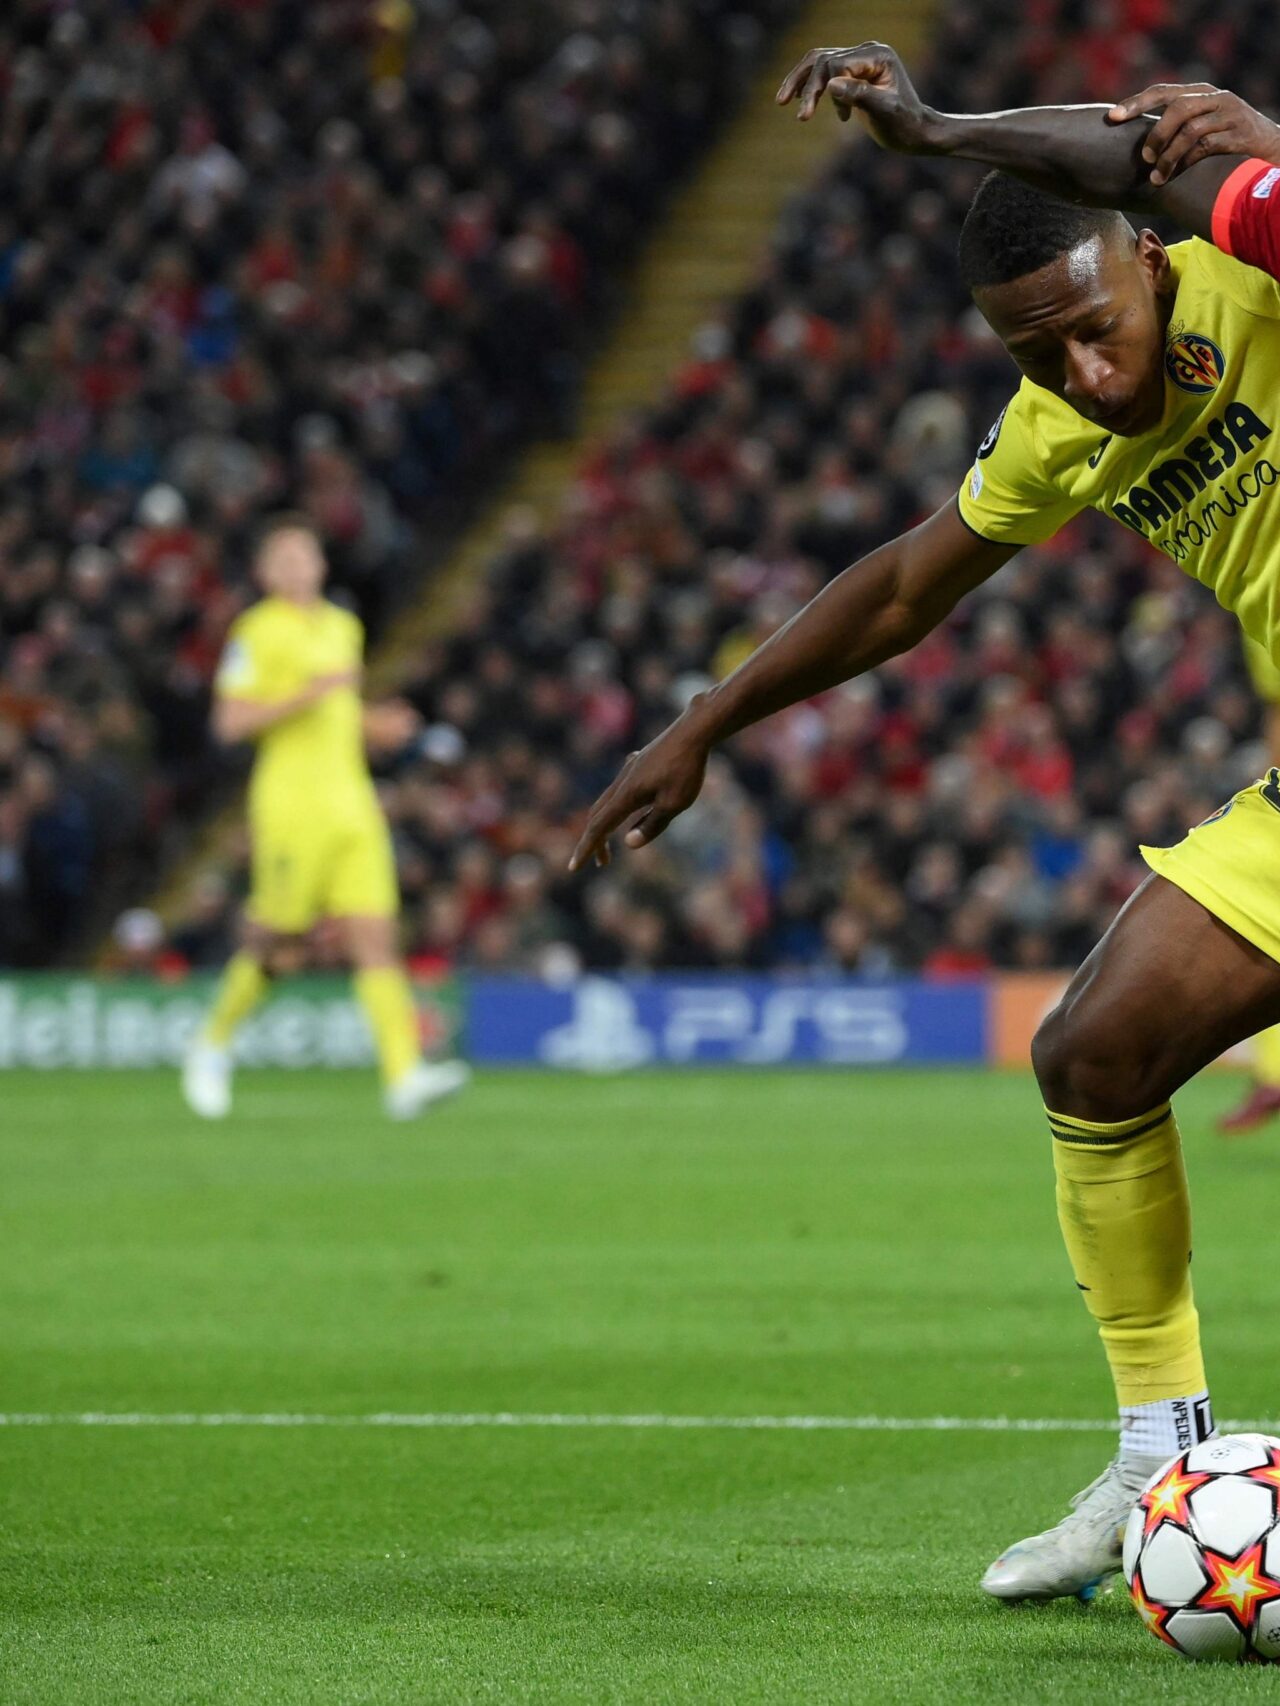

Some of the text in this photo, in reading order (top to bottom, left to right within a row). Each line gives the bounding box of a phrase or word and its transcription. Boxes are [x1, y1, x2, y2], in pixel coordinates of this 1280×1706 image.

[1111, 402, 1272, 539] PAMESA
[0, 980, 388, 1068] eineen
[663, 986, 909, 1064] PS5
[1171, 1396, 1191, 1450] APEDES
